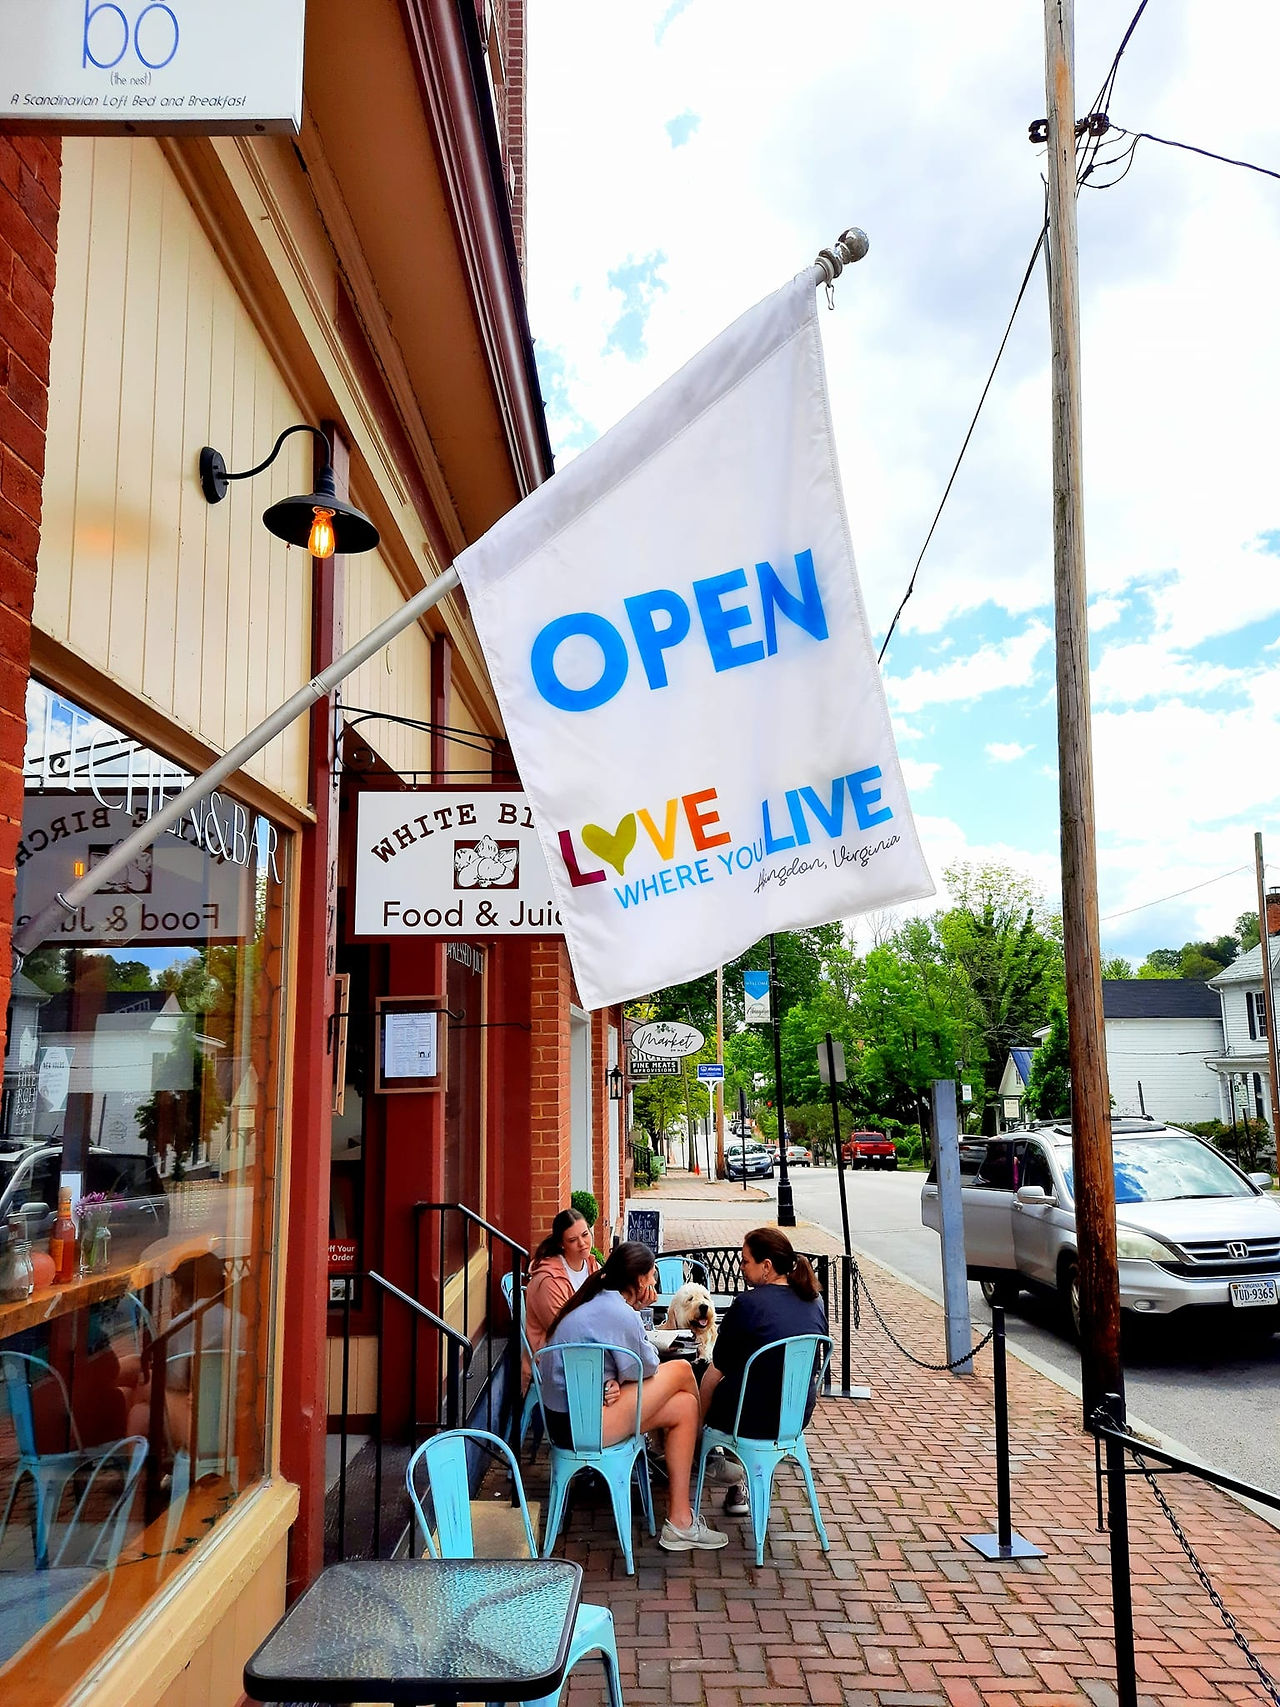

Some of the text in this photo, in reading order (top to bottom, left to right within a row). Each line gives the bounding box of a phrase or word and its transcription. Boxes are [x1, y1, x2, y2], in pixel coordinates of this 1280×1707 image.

[10, 93, 247, 109] A Scandinavian Loft Bed and Breakfast
[530, 548, 829, 712] OPEN
[761, 765, 894, 856] LIVE
[371, 803, 477, 864] WHITE
[832, 835, 902, 868] Virginia
[613, 838, 763, 909] WHERE YOU
[383, 900, 464, 927] Food
[475, 900, 499, 927] &
[639, 1030, 697, 1049] Market
[652, 1061, 676, 1069] MEATS
